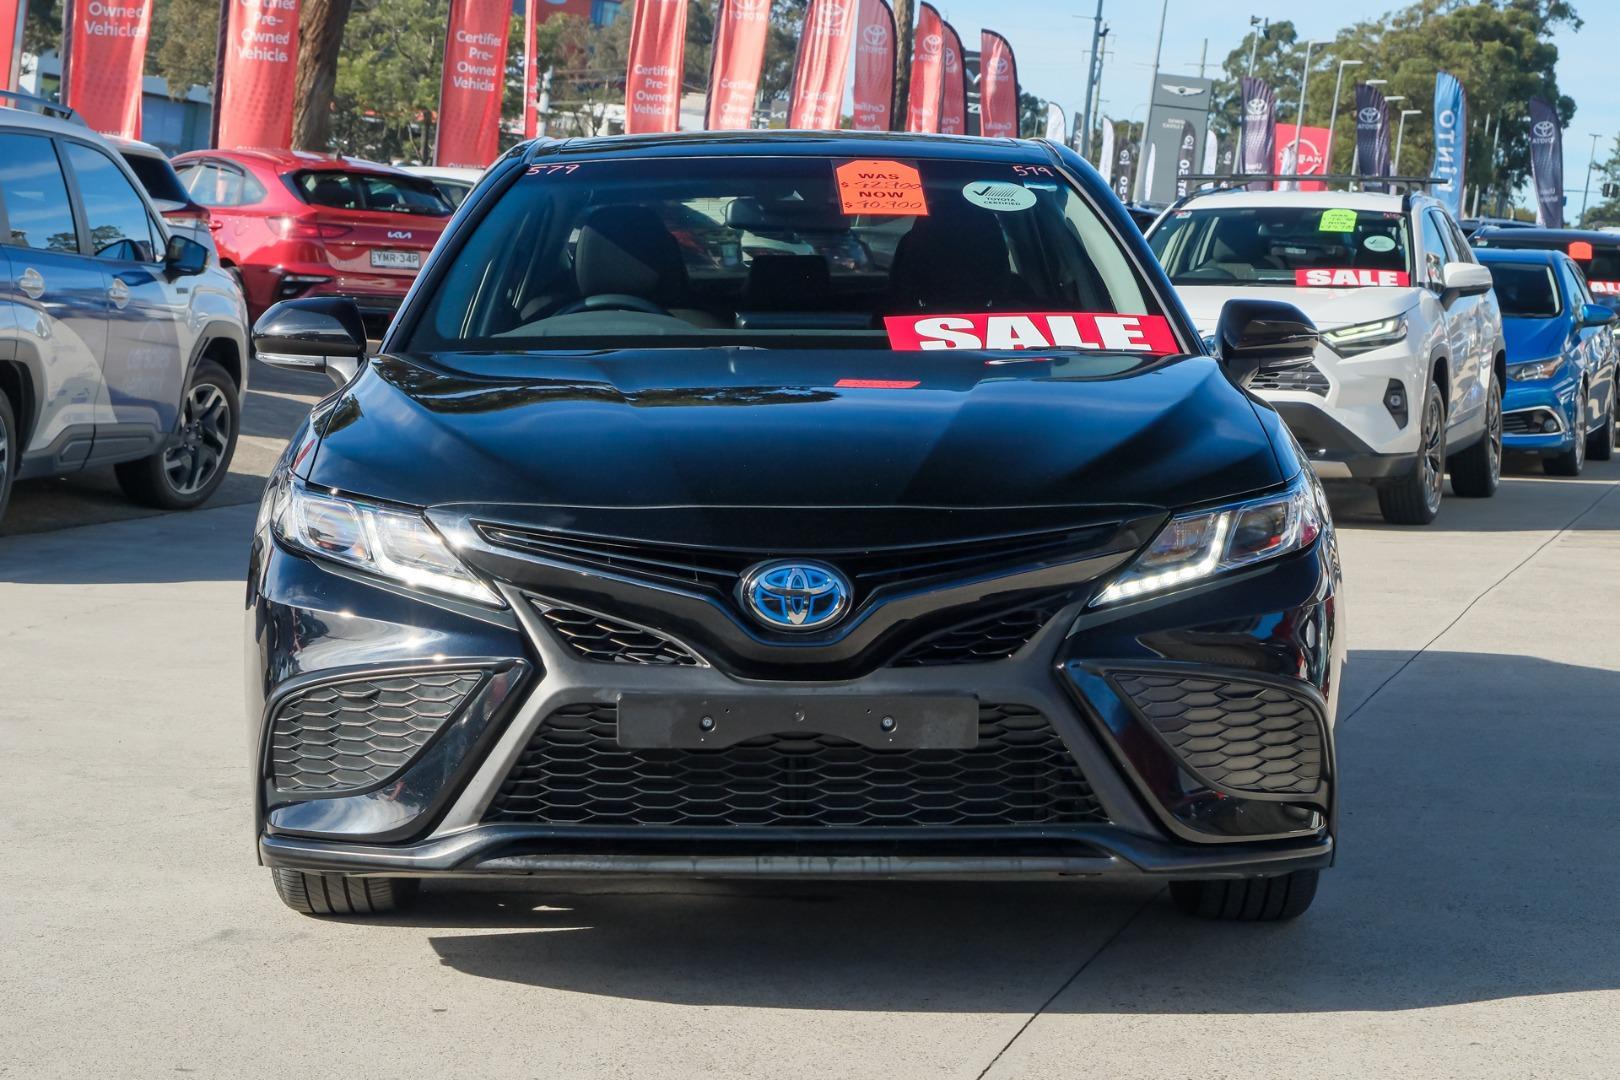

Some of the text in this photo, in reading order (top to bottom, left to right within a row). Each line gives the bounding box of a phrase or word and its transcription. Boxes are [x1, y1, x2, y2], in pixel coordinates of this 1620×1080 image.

[241, 27, 290, 45] Owned
[468, 46, 493, 60] Pre-
[526, 164, 580, 175] 579
[1012, 165, 1055, 177] 579
[1306, 269, 1399, 287] SALE
[914, 316, 1153, 351] SALE
